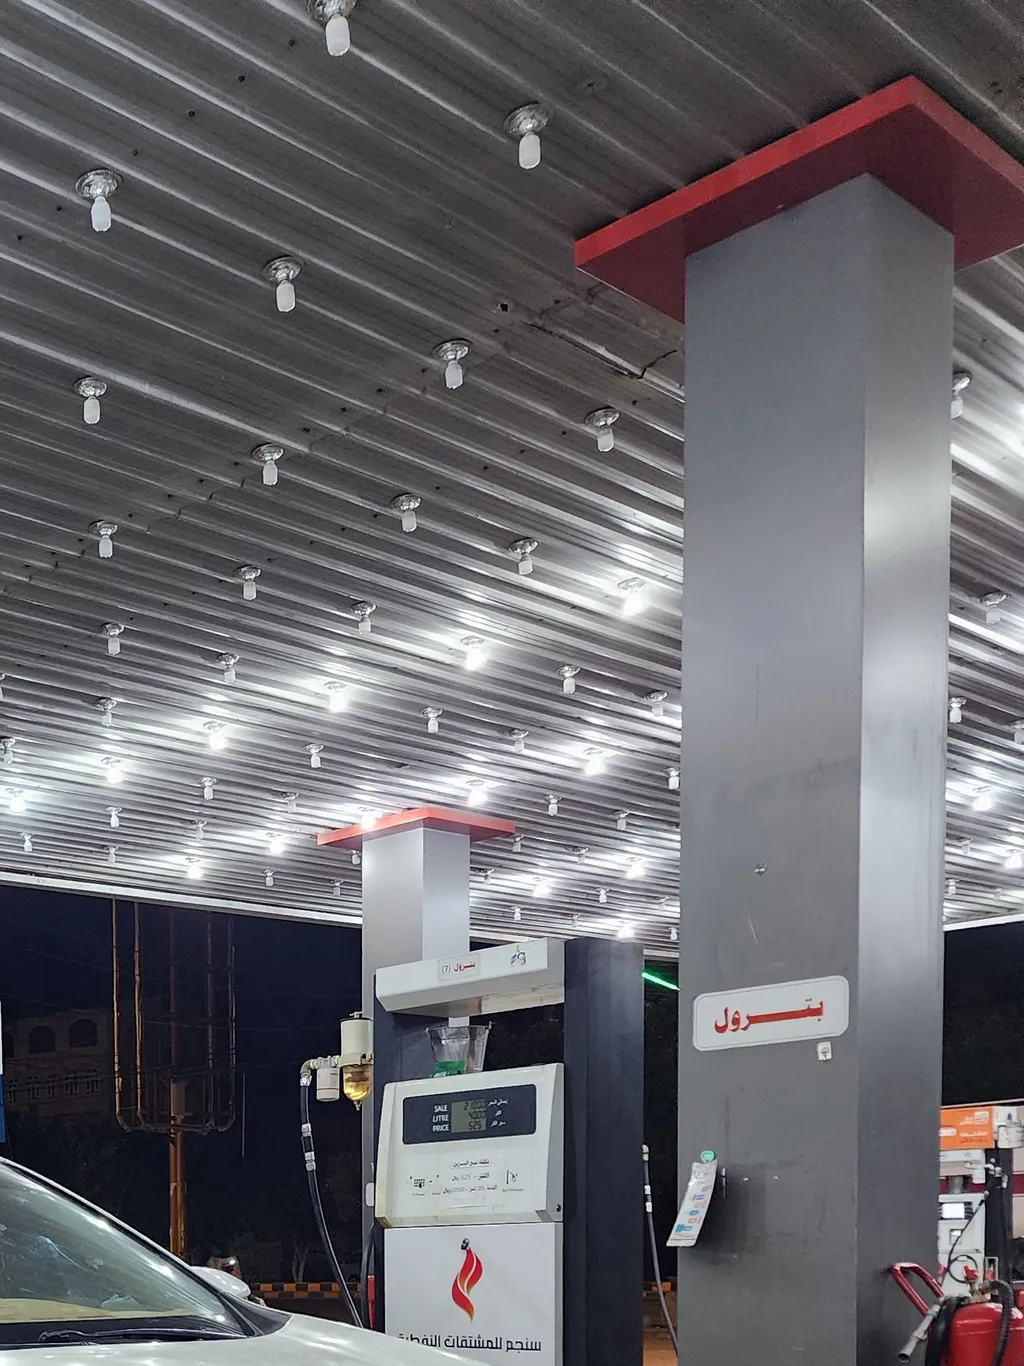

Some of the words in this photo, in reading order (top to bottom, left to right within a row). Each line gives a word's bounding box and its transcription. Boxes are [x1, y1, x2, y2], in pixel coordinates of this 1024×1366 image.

[454, 960, 476, 972] بترول
[714, 998, 824, 1034] بترول
[434, 1104, 448, 1112] SALE
[432, 1114, 449, 1122] LITRE
[432, 1124, 449, 1132] PRICE
[469, 1121, 482, 1130] 525
[444, 1333, 503, 1350] للمشتقات
[506, 1337, 542, 1353] سنجم
